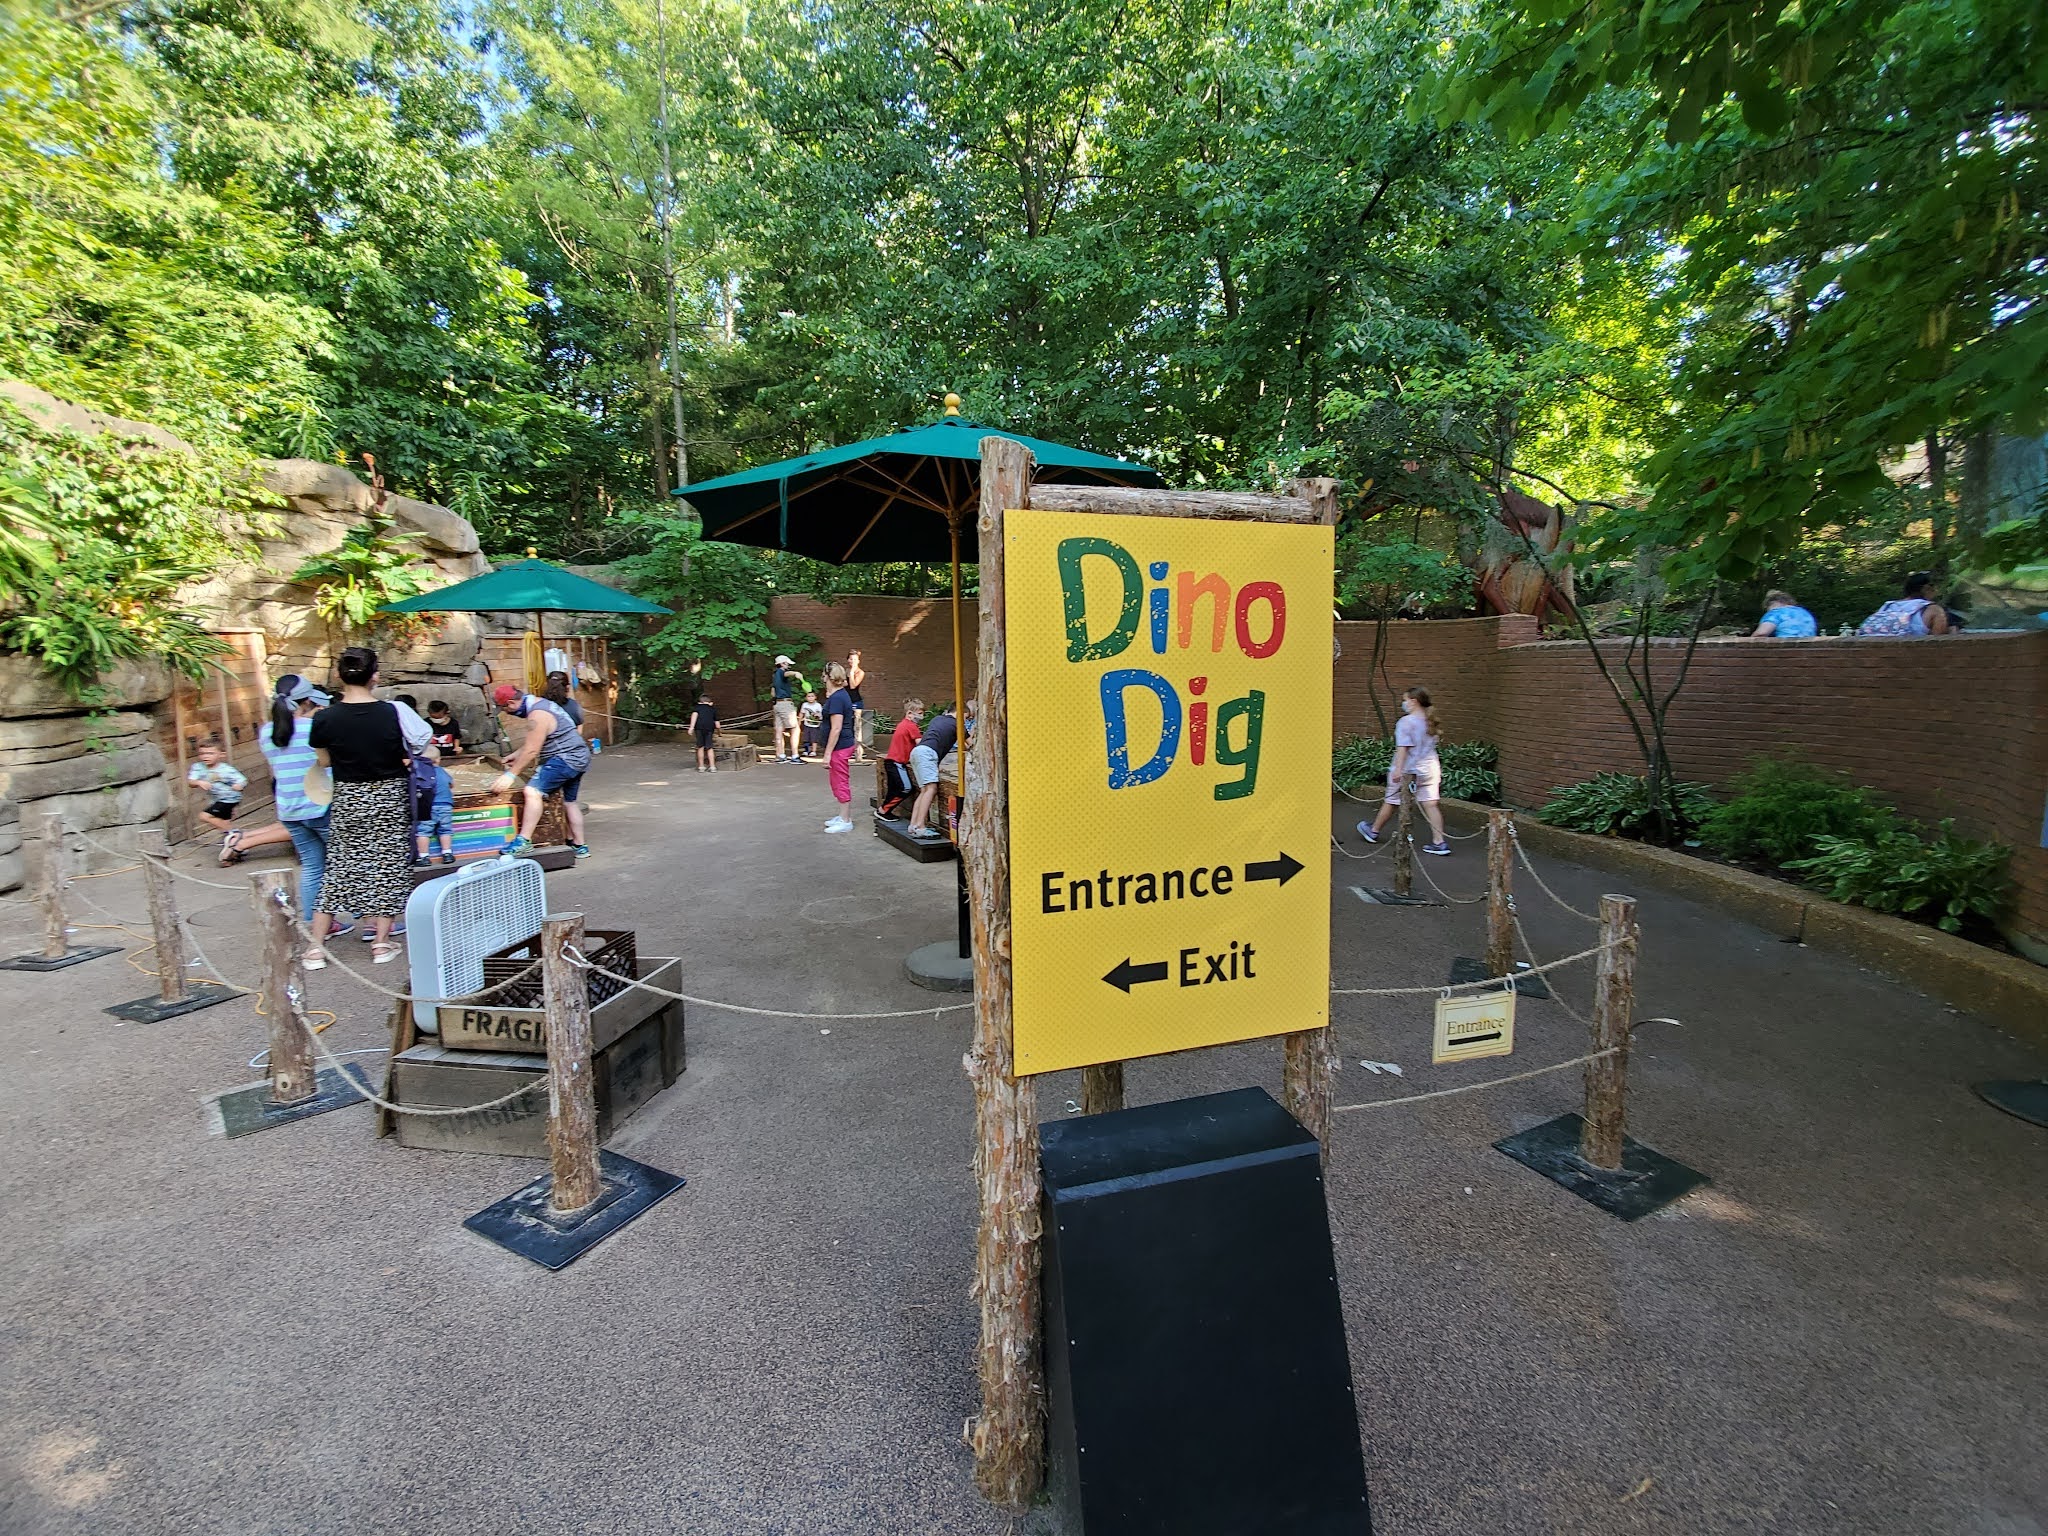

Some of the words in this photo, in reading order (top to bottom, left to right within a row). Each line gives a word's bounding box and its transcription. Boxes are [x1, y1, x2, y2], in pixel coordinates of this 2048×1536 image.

[1057, 537, 1286, 663] Dino
[1100, 668, 1265, 801] Dig
[1041, 865, 1233, 914] Entrance
[1179, 940, 1256, 987] Exit
[462, 1009, 547, 1046] FRAGI
[1447, 1017, 1506, 1035] Entrance
